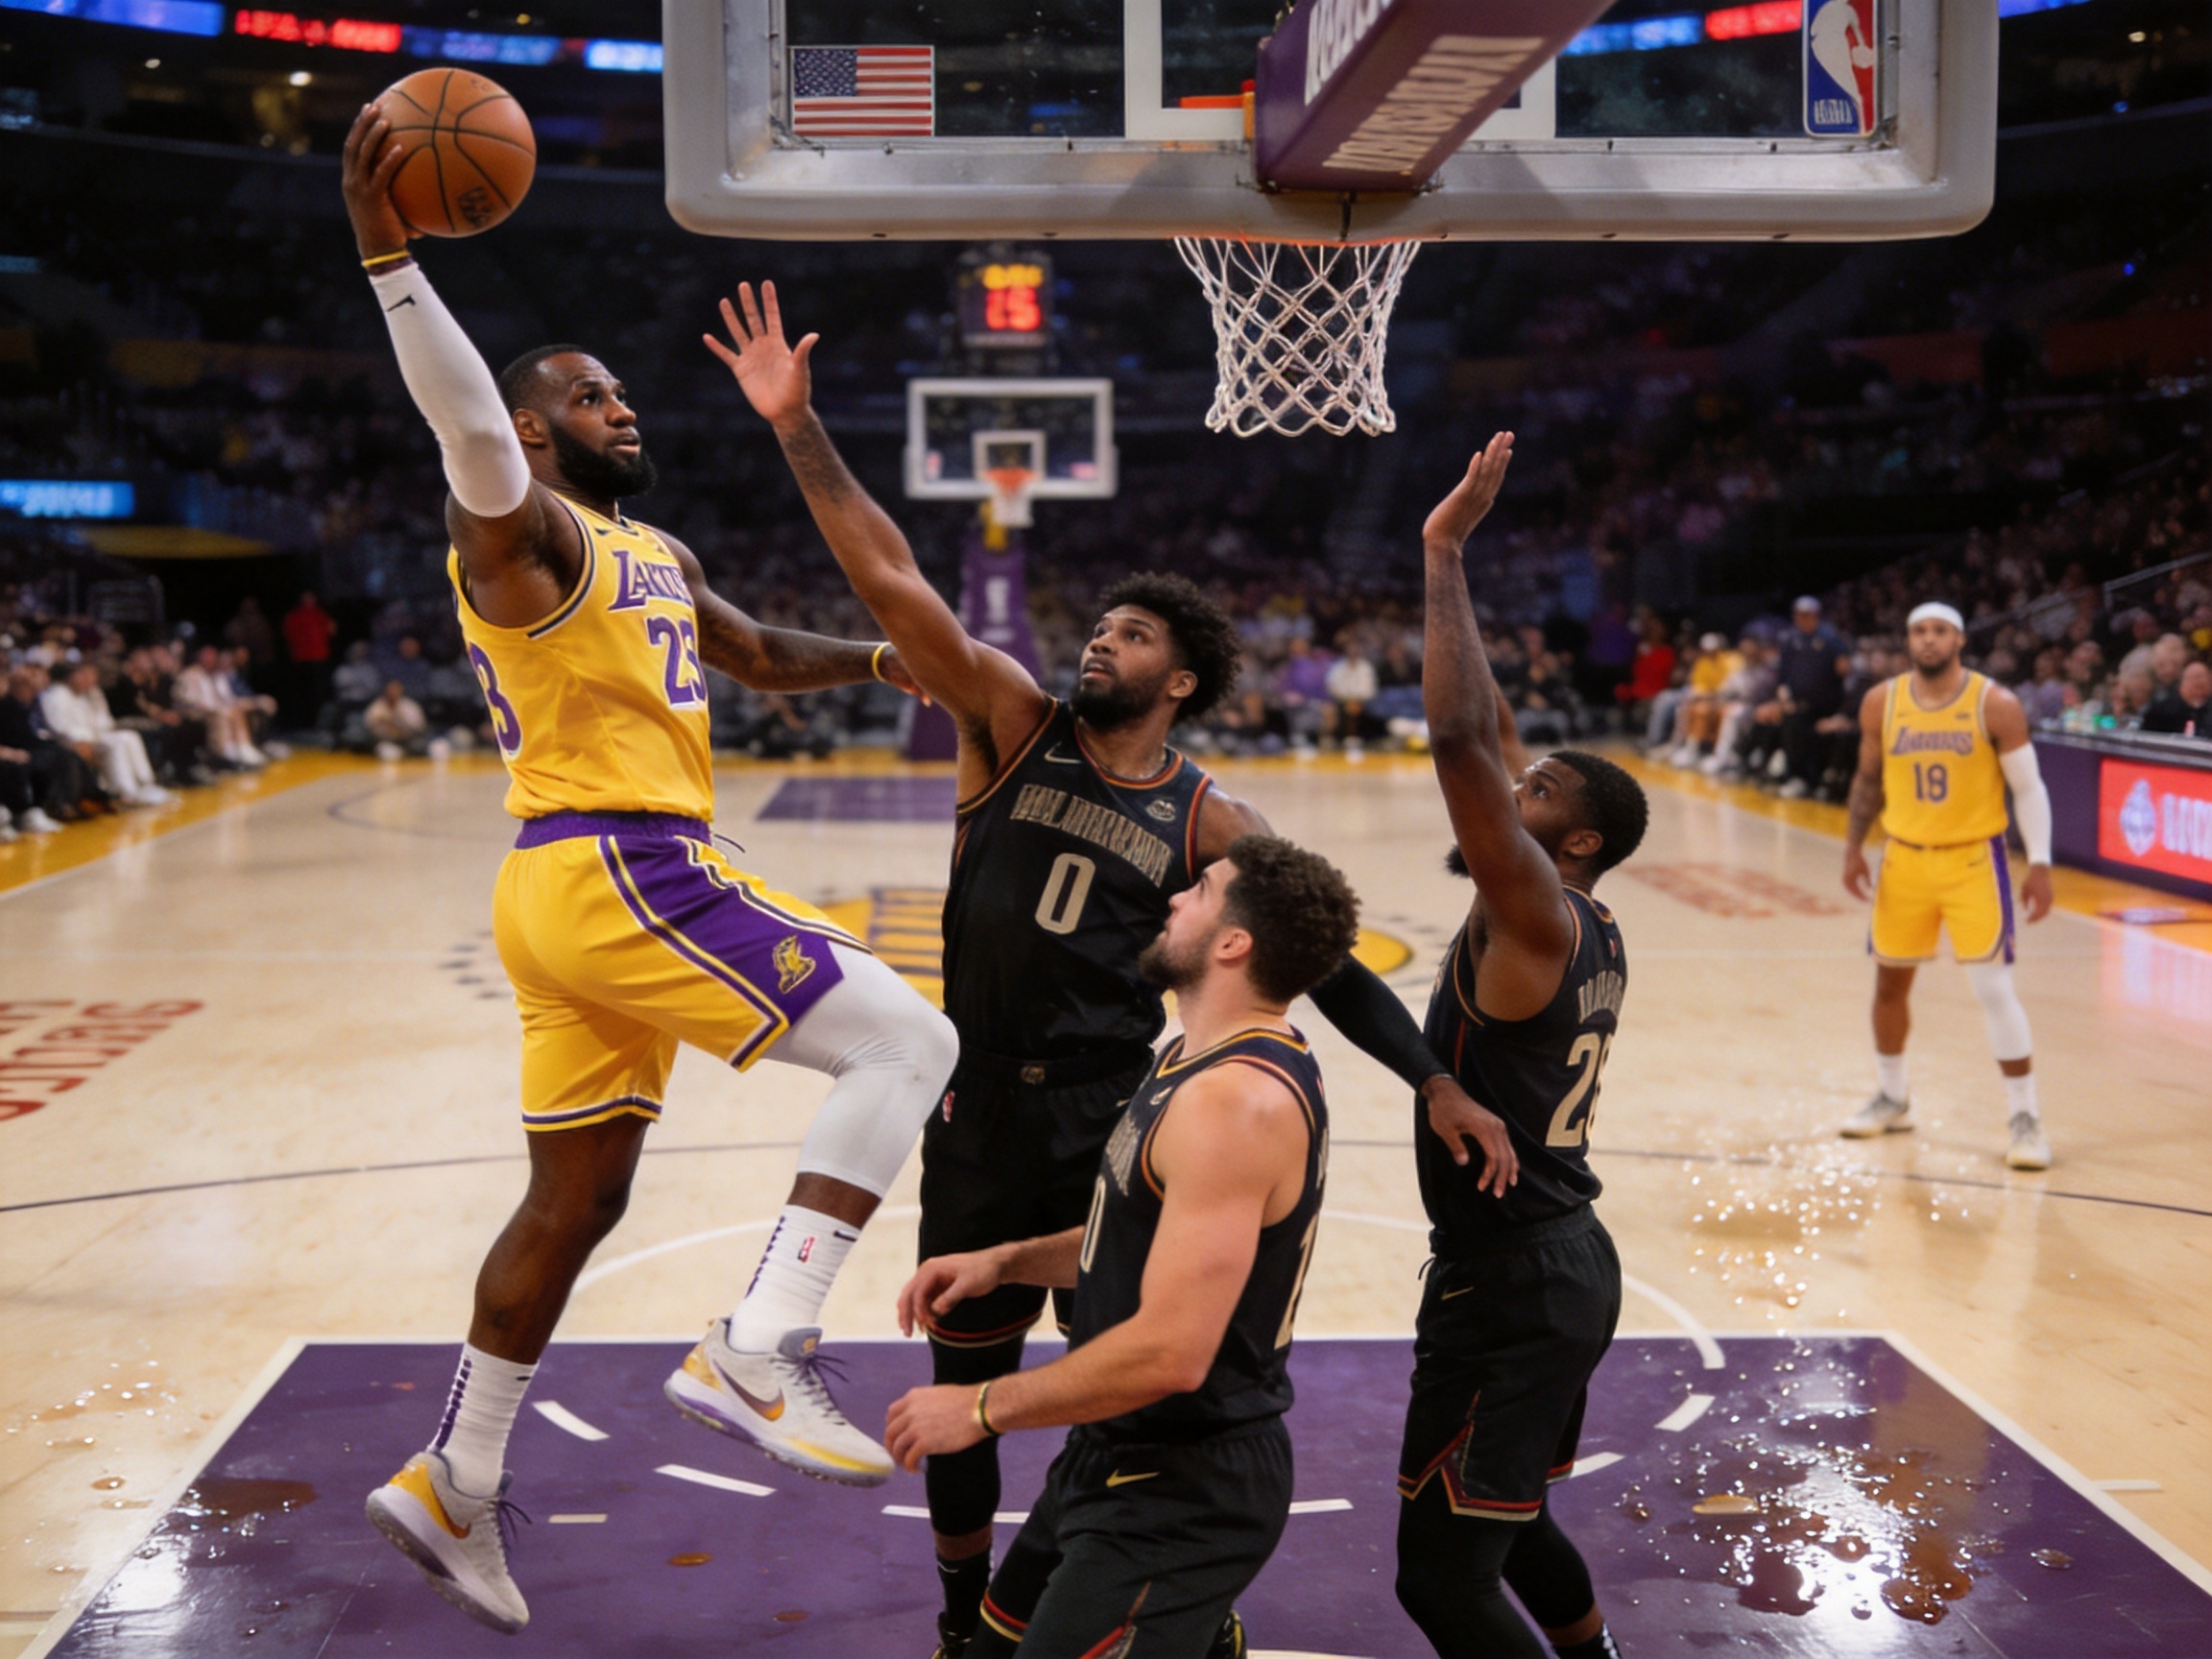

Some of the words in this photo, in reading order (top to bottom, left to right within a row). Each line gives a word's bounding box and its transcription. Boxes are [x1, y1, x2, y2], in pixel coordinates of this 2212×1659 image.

[645, 615, 708, 707] 23
[1913, 761, 1949, 804] 18
[1035, 853, 1096, 935] 0
